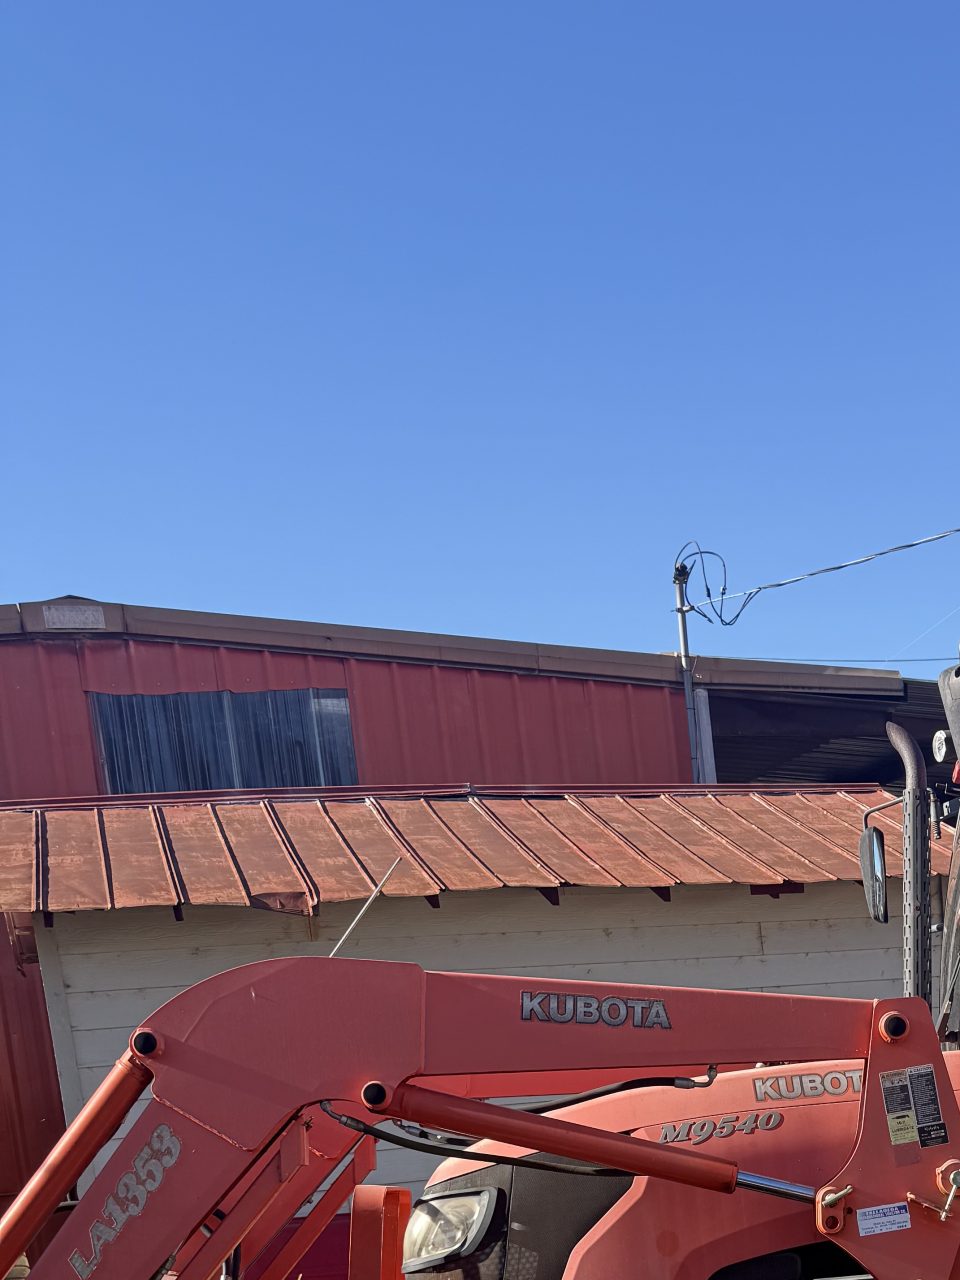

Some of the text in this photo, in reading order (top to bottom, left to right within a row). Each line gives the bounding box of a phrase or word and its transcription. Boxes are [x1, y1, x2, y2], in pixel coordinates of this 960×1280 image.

[521, 990, 672, 1029] KUBOTA
[754, 1070, 863, 1102] KUBOT
[659, 1111, 784, 1145] M9540
